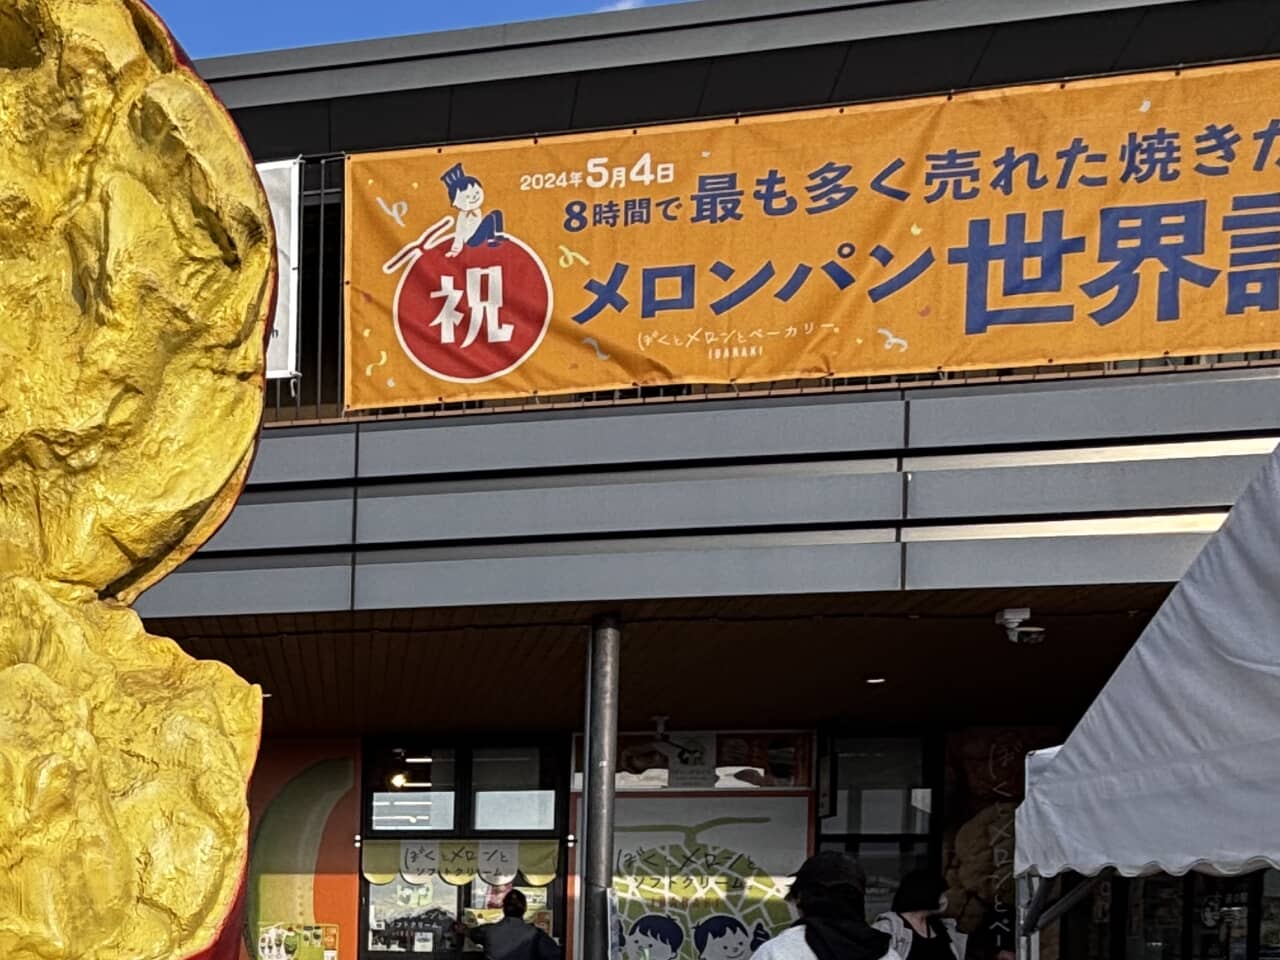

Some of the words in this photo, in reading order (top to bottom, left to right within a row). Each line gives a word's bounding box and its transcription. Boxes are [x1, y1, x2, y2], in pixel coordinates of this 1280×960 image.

[519, 153, 675, 191] 2024年5月4日
[428, 265, 515, 349] 祝
